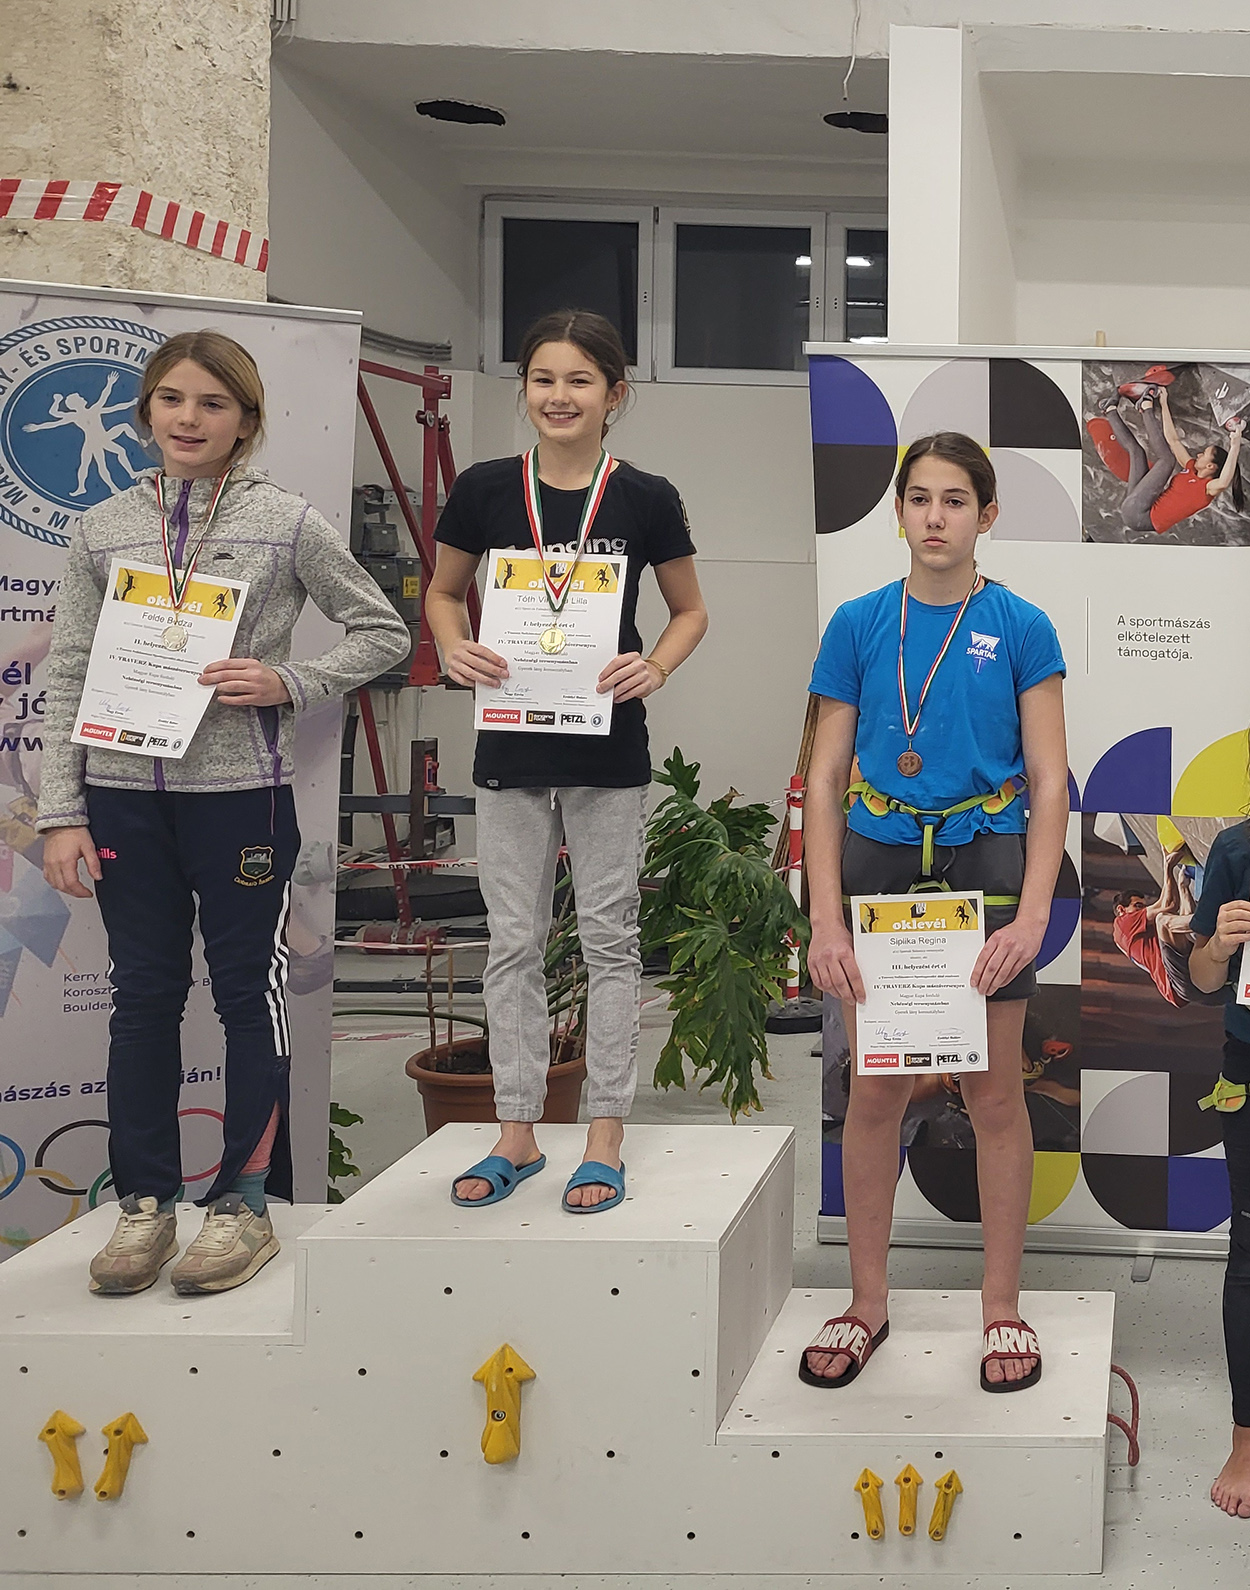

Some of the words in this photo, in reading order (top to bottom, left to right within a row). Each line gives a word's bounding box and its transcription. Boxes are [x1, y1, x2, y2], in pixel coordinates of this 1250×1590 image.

[19, 343, 51, 369] ÉS
[56, 335, 151, 365] SPORTM
[1116, 615, 1126, 626] A
[1129, 616, 1211, 629] sportmászás
[1117, 631, 1191, 644] elkötelezett
[966, 647, 997, 662] SPARTAK
[1117, 646, 1193, 661] támogatója.
[485, 712, 519, 720] MOUNTEX
[561, 713, 586, 726] PETZL
[83, 726, 113, 738] MOUNTEX
[147, 736, 169, 748] PETZL
[892, 918, 947, 930] oklevél
[918, 936, 947, 945] Regina
[63, 972, 99, 984] Kerry
[936, 1053, 963, 1066] PETZL
[0, 1081, 70, 1102] ászás
